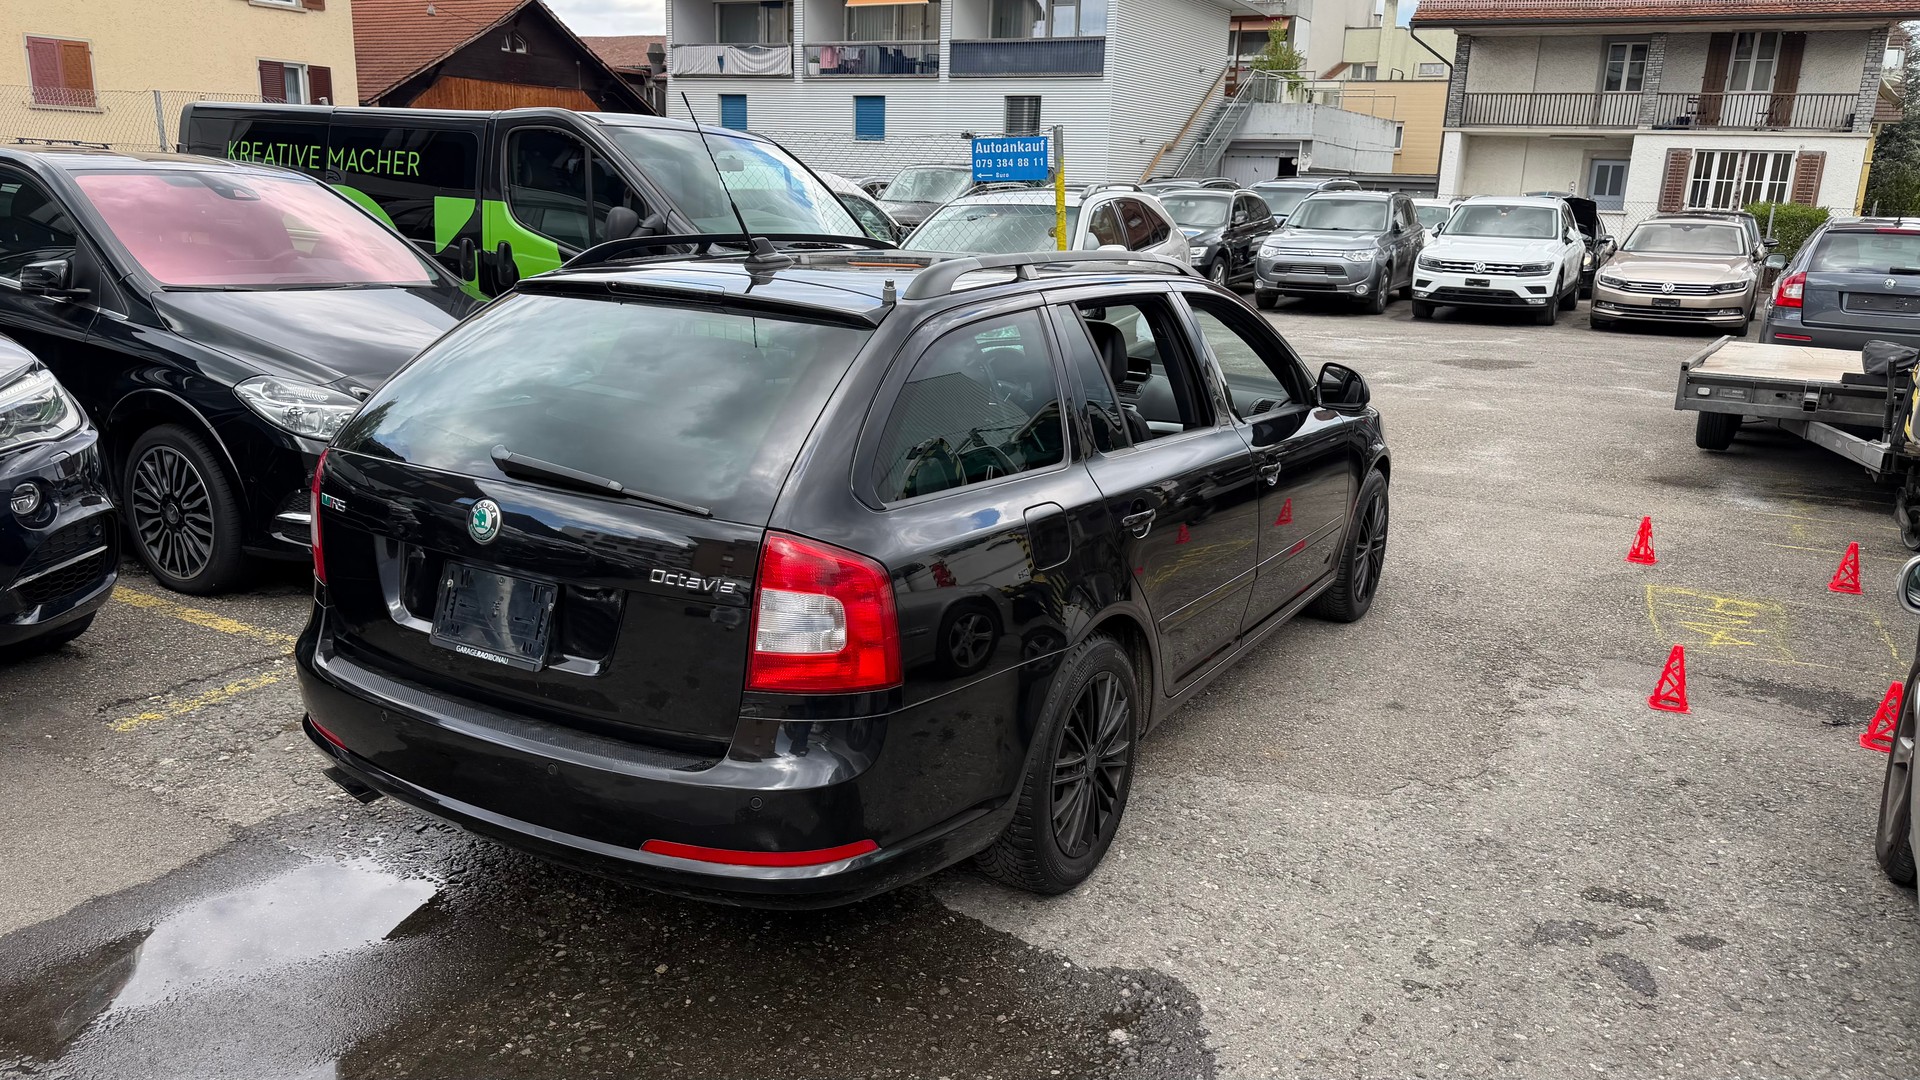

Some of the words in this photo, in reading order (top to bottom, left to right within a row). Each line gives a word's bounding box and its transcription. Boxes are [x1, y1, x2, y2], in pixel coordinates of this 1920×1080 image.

[975, 140, 1045, 154] Autoankauf
[228, 140, 321, 169] KREATIVE
[327, 147, 420, 176] MACHER
[975, 158, 993, 168] 079
[996, 158, 1014, 167] 384
[1017, 157, 1029, 167] 88
[1033, 157, 1044, 166] 11
[649, 568, 736, 594] Octavia
